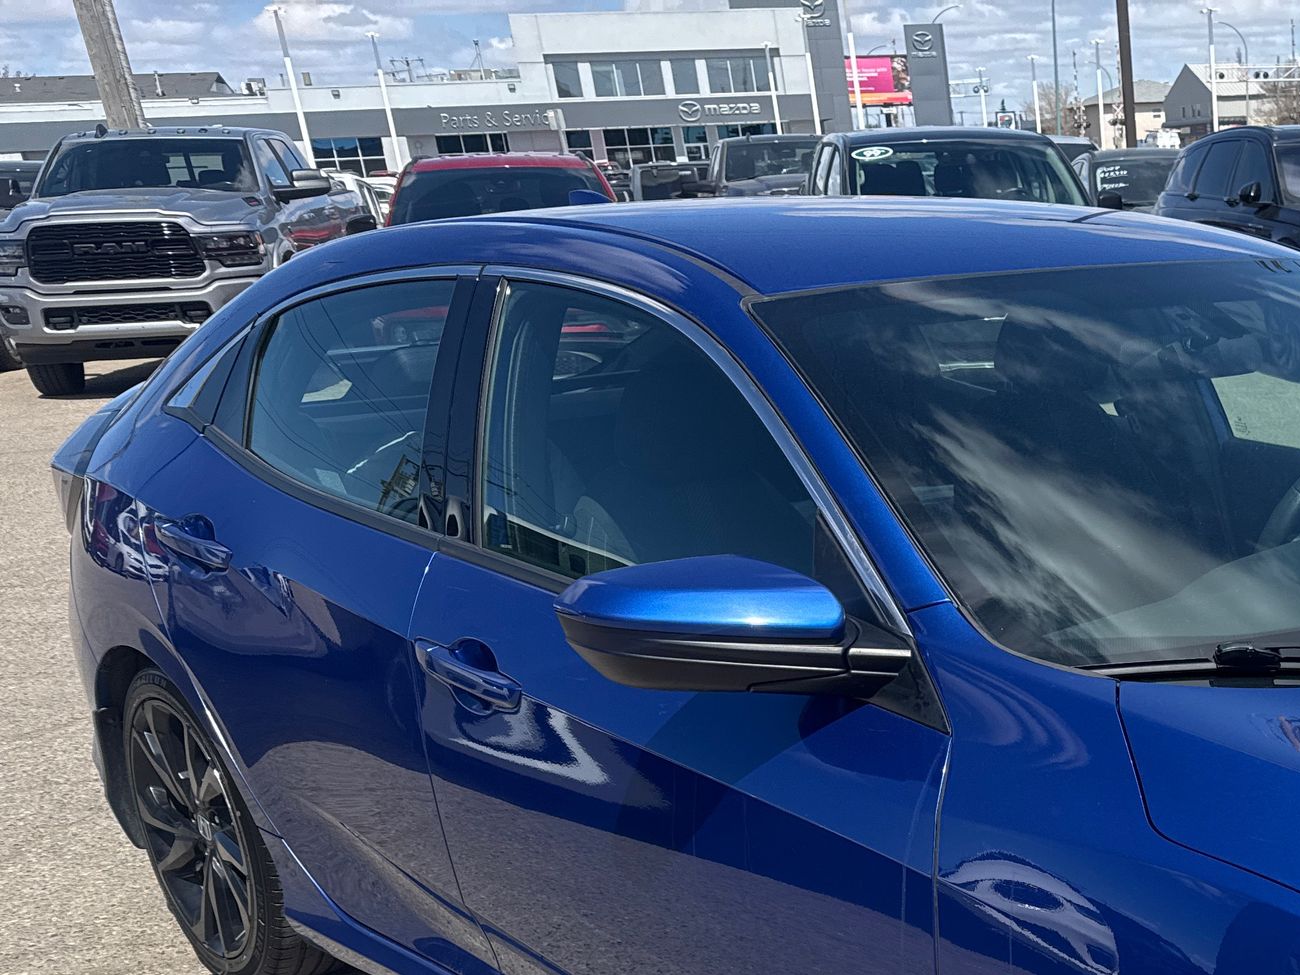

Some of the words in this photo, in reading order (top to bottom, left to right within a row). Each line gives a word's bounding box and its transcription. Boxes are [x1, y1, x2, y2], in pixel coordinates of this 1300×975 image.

[704, 103, 761, 115] mazda
[440, 112, 479, 128] Parts
[485, 111, 498, 127] &
[502, 109, 550, 127] Servic
[73, 242, 149, 254] RAM
